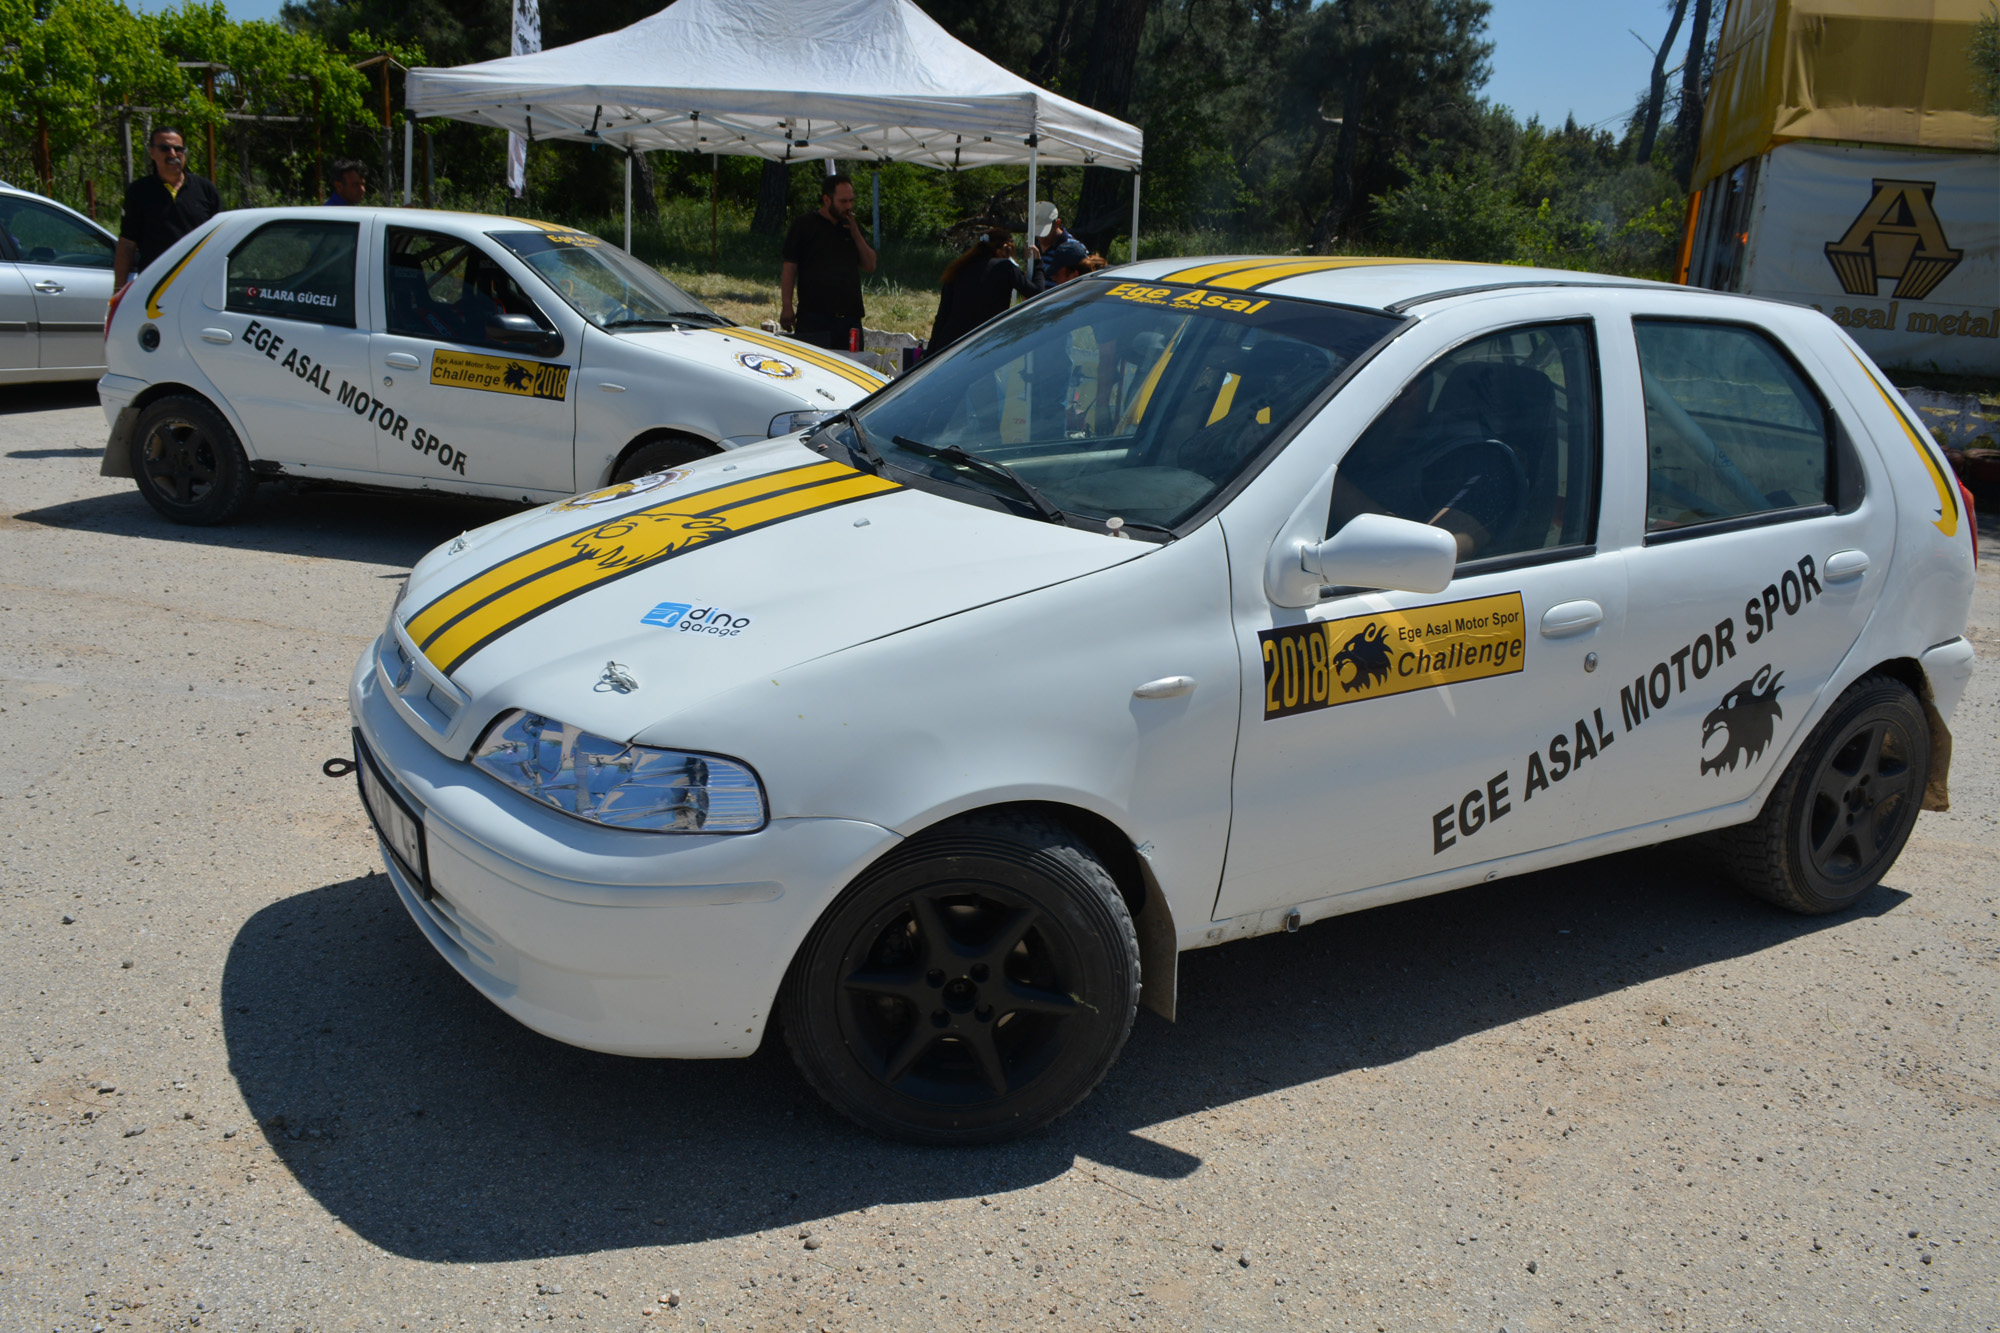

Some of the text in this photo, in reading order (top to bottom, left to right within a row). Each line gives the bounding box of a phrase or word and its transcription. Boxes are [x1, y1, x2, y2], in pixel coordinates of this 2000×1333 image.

[259, 288, 338, 307] ALARA GÜCELİ
[1105, 283, 1271, 315] Ege Asal
[1832, 301, 2000, 338] asal metal
[432, 367, 501, 387] Challenge
[435, 357, 448, 365] Ege
[465, 360, 484, 369] Motor
[485, 362, 501, 371] Spor
[242, 320, 468, 476] EGE ASAL MOTOR SPOR
[534, 365, 569, 398] 2018
[680, 620, 741, 637] garage
[689, 607, 750, 628] dino
[1399, 610, 1519, 643] Ege Asal Motor Spor
[1263, 632, 1328, 712] 2018
[1397, 637, 1522, 677] Challenge
[1432, 554, 1822, 855] EGE ASAL MOTOR SPOR
